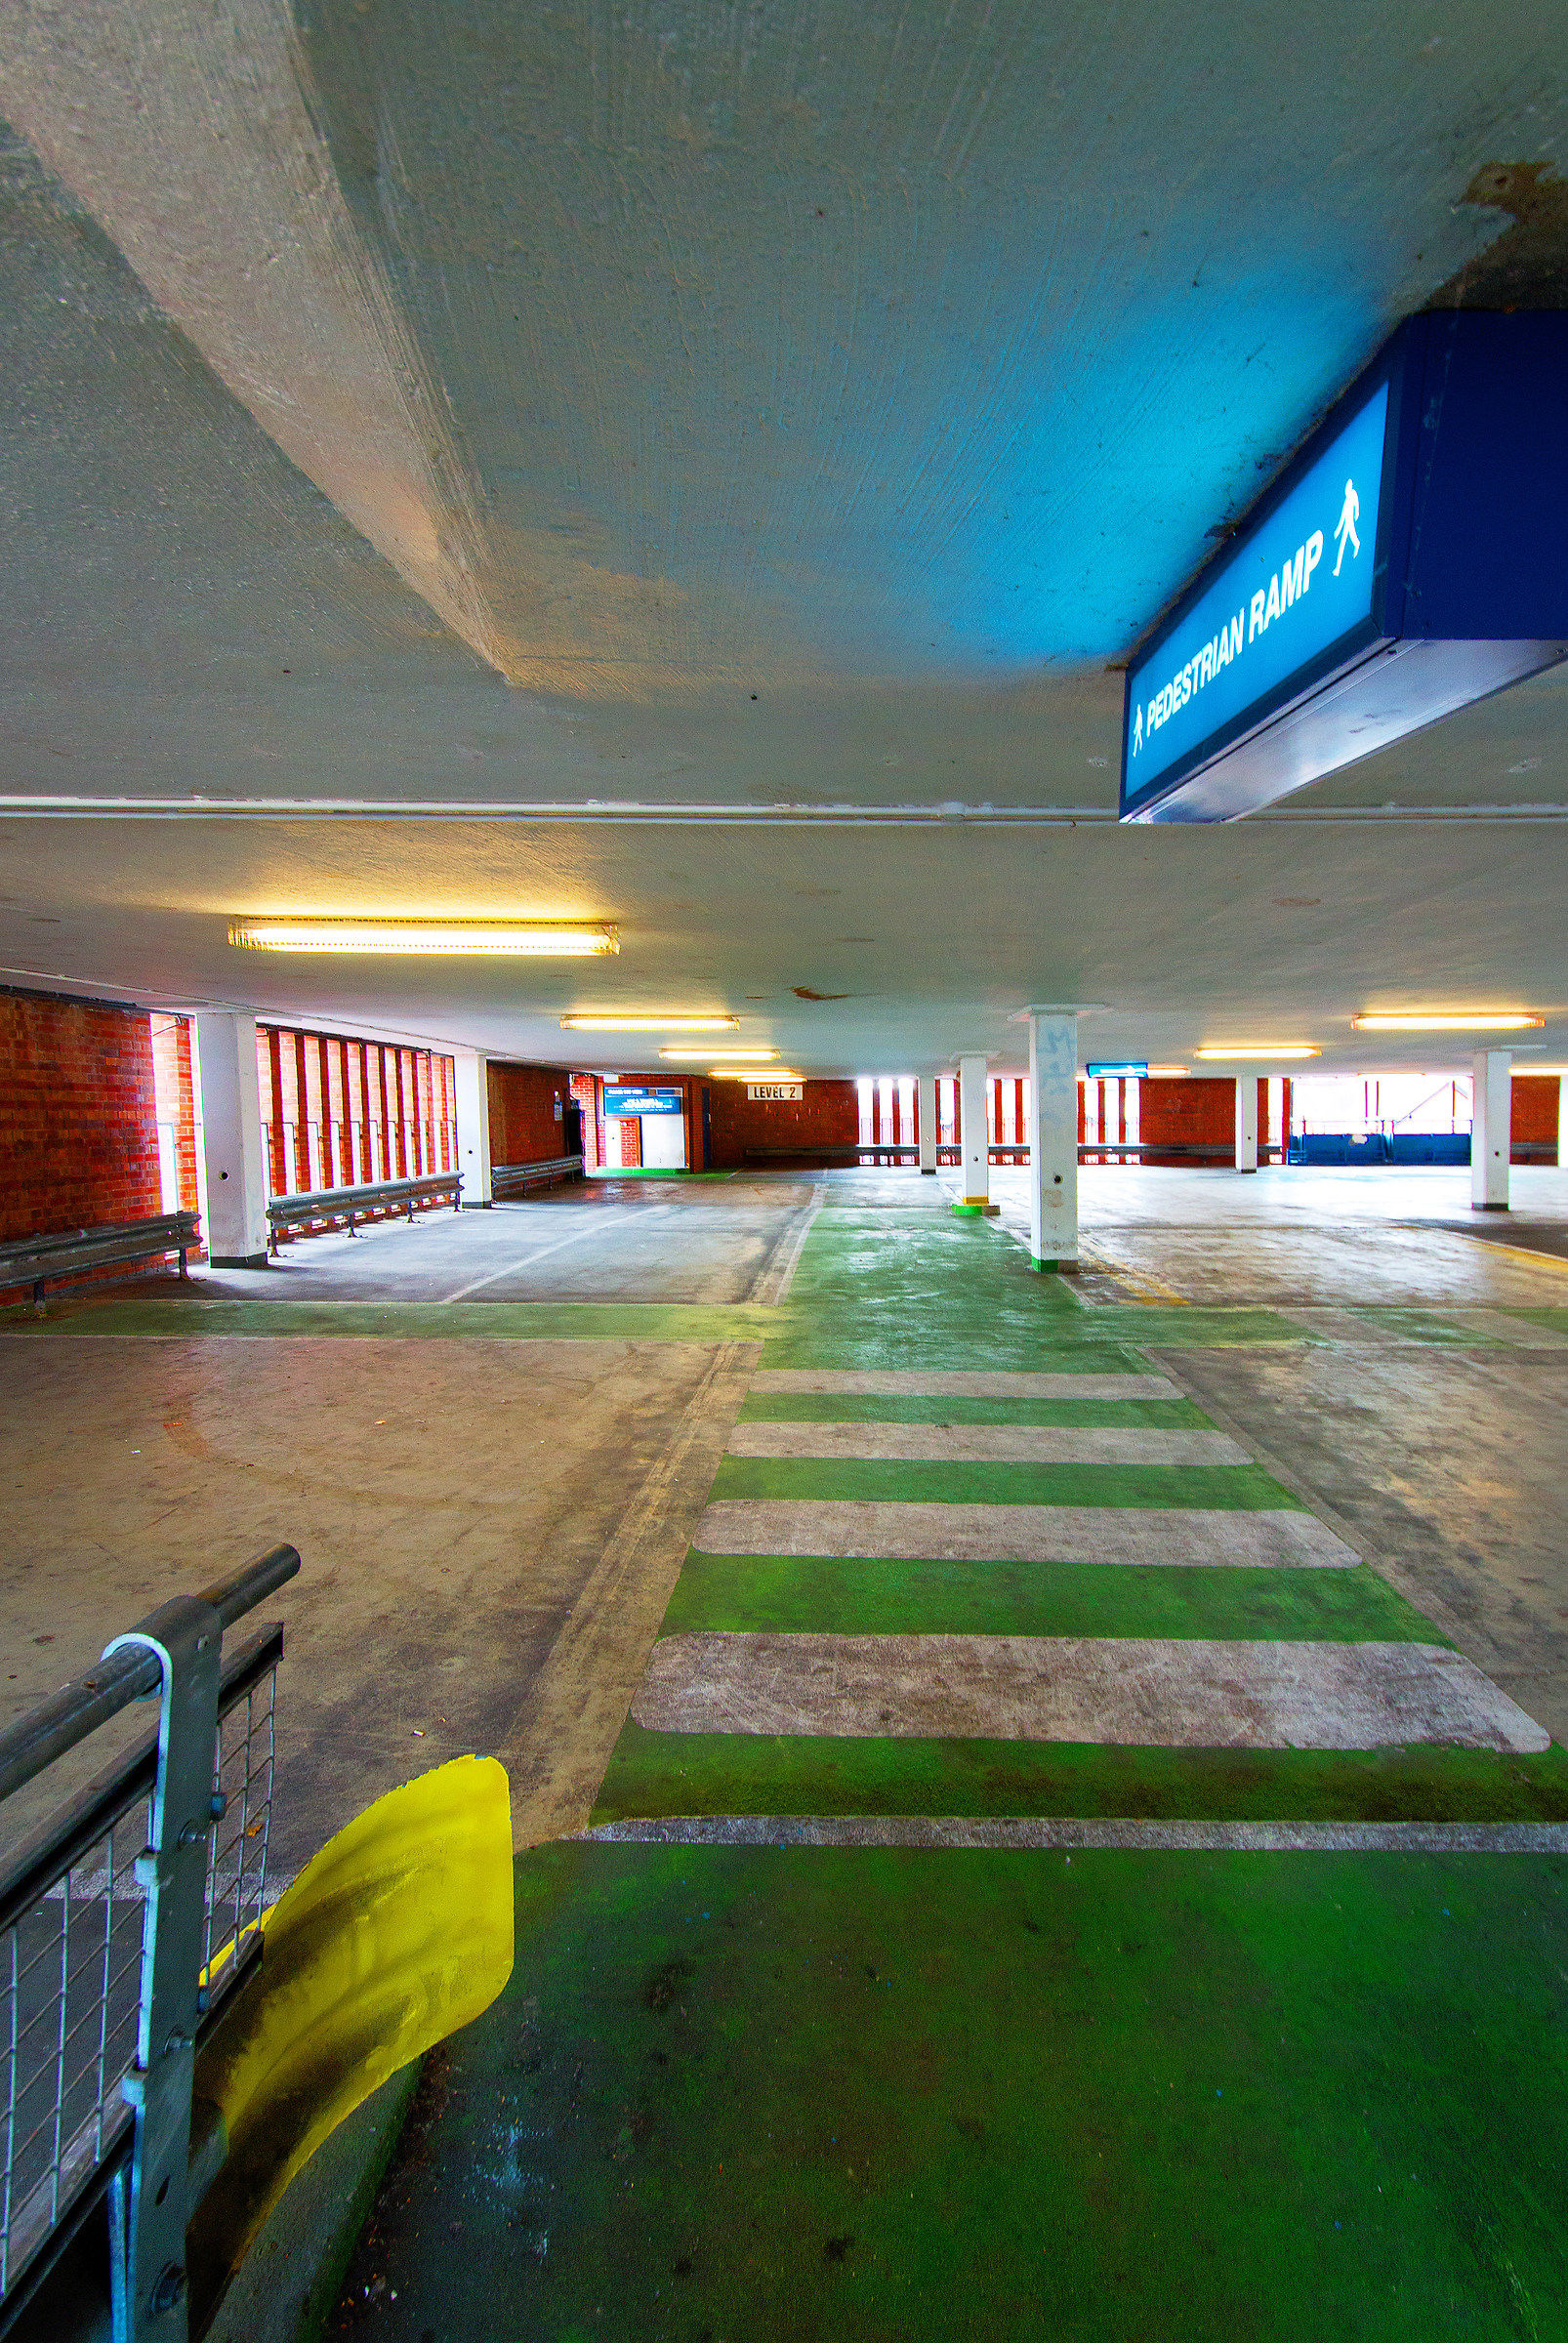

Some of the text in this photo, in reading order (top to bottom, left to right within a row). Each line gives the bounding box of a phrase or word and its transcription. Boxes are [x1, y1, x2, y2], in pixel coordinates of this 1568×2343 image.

[1146, 529, 1324, 738] PEDESTRIAN RAMP
[754, 1087, 796, 1098] LEVEL 2
